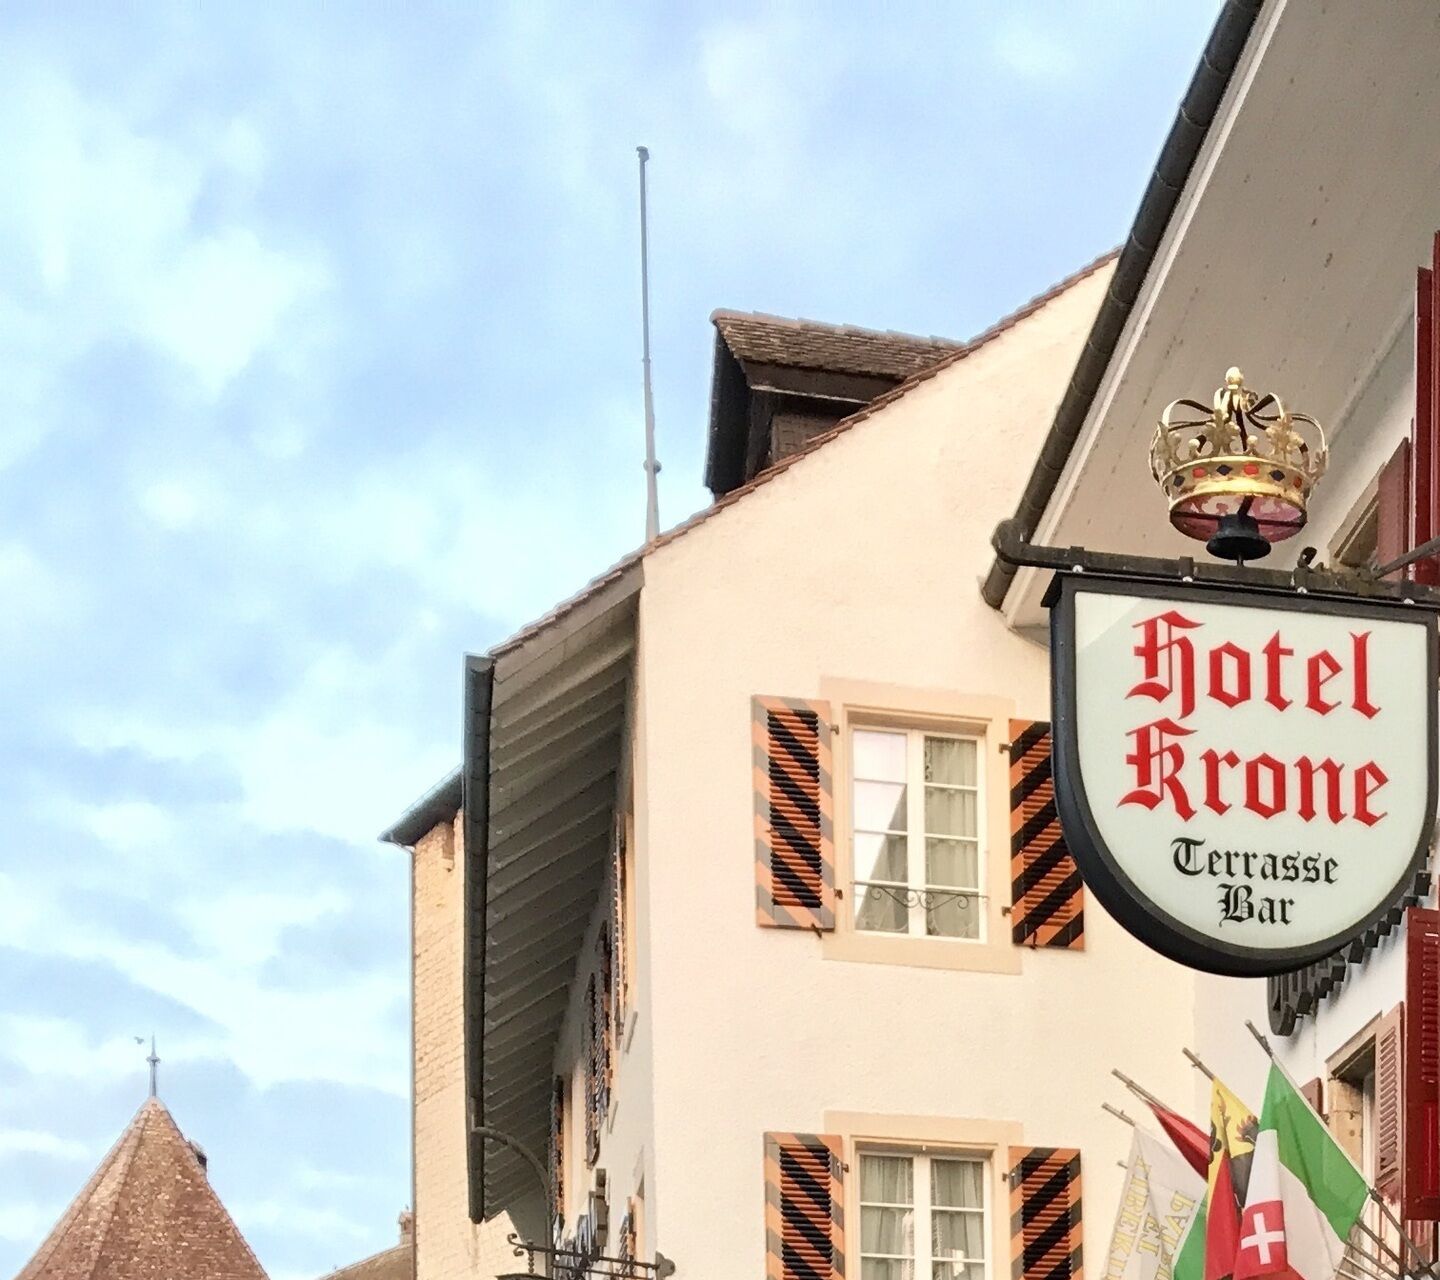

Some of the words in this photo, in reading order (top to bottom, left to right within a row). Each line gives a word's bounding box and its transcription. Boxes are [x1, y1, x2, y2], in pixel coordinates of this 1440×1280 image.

[1125, 610, 1382, 720] Hotel
[1117, 717, 1390, 828] Krone
[1170, 837, 1339, 886] Terrasse
[1217, 883, 1296, 928] Bar
